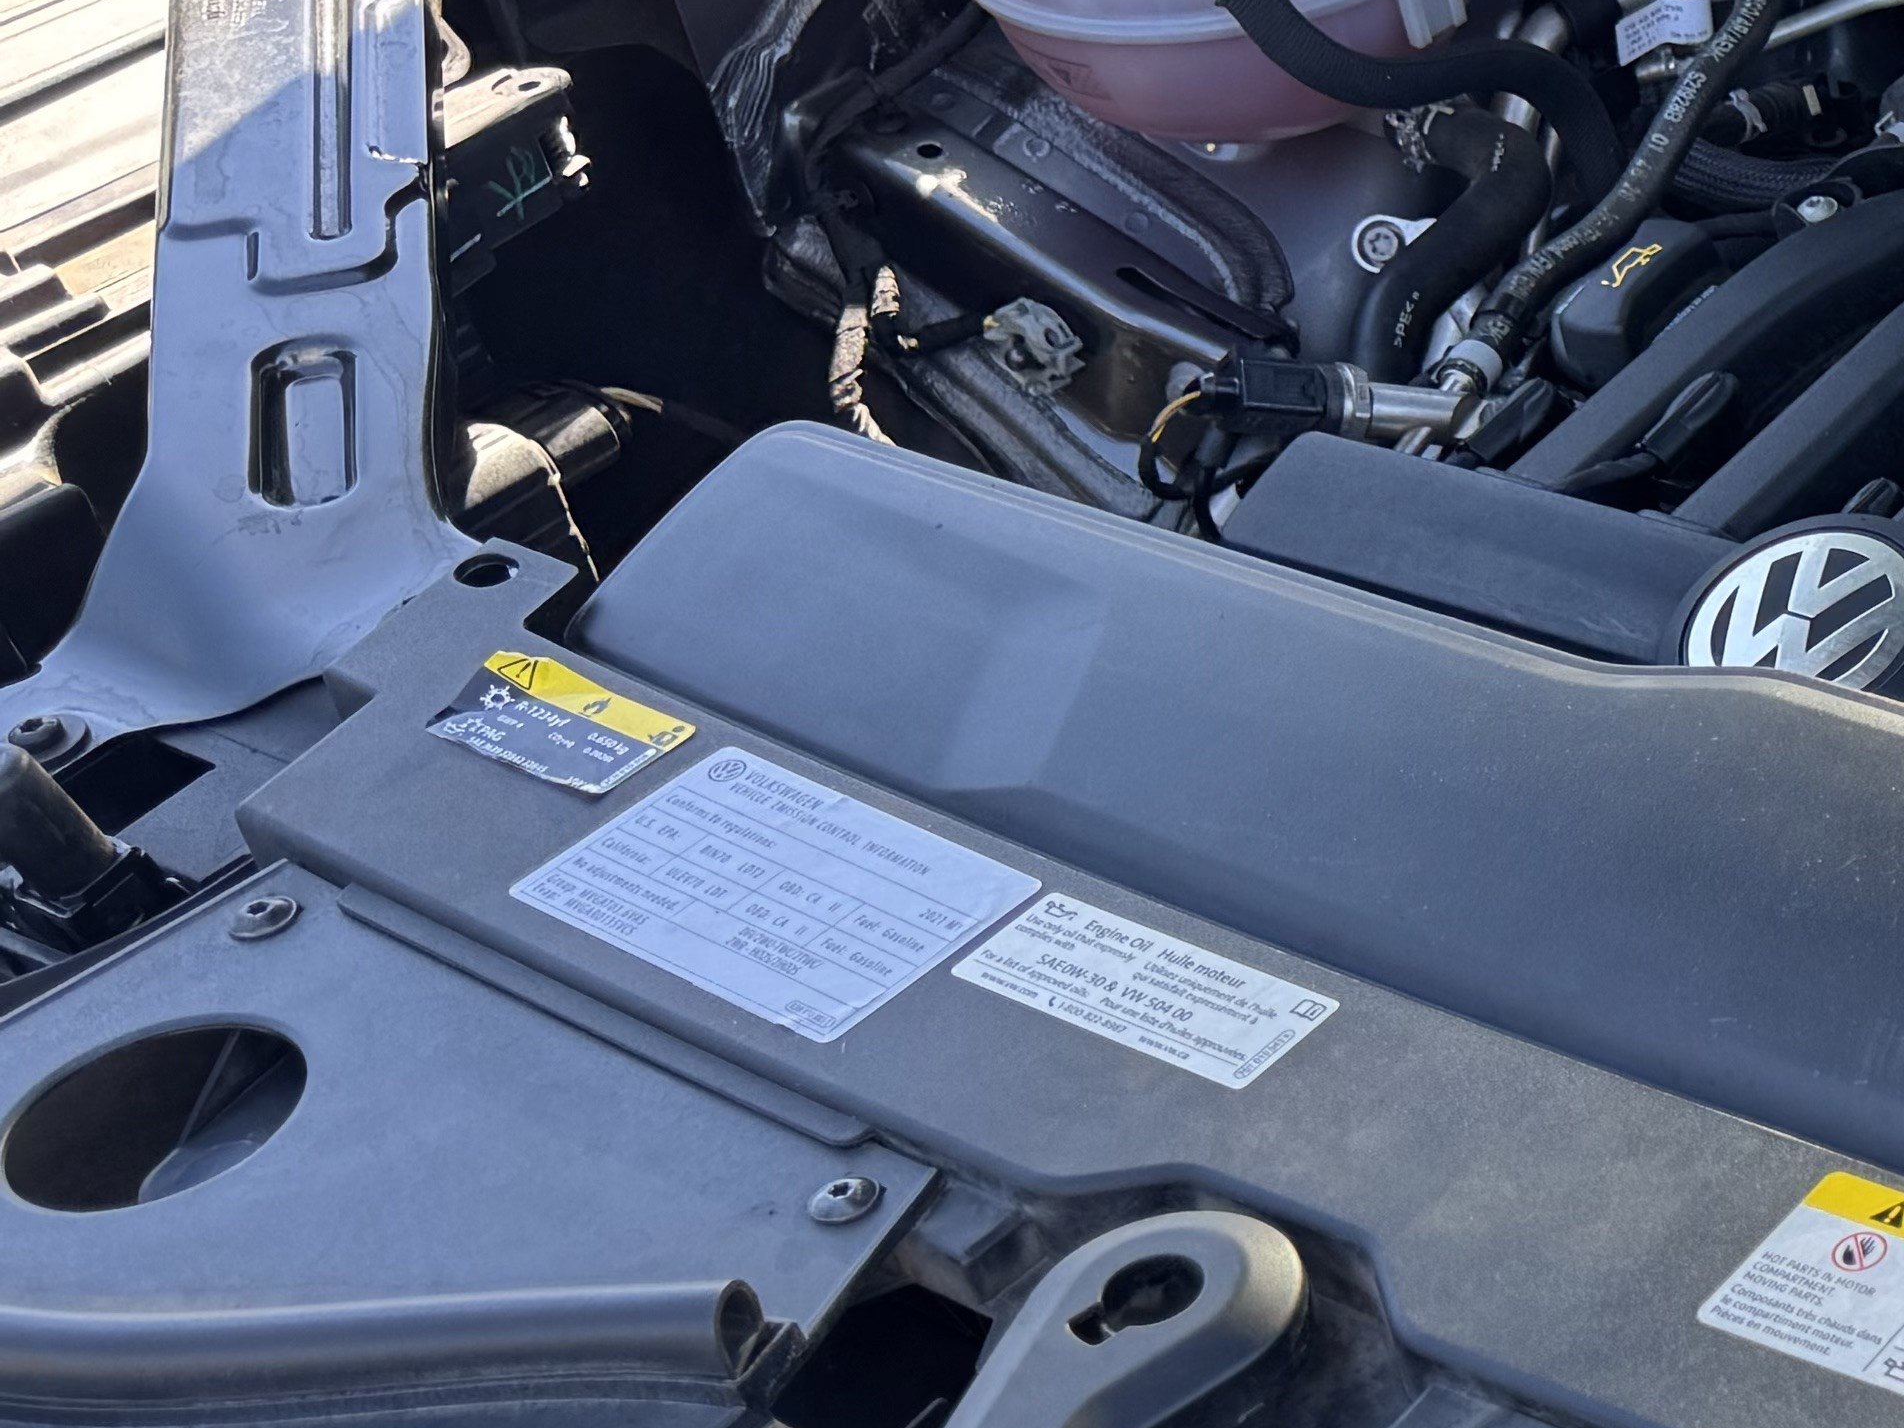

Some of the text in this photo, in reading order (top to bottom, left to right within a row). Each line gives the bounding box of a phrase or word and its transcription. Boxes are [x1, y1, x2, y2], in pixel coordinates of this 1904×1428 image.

[663, 794, 713, 818] Conforms
[741, 771, 825, 810] VOLKSWAGEN
[726, 782, 933, 875] VEHICLE EMISSION CONTROL INFORMATION
[584, 863, 646, 894] adjustments
[916, 908, 948, 925] 2021
[880, 926, 930, 952] Gasoline
[1079, 919, 1155, 951] Engine Oil
[847, 950, 897, 976] Gasoline
[1156, 948, 1249, 989] Huile moteur
[1101, 980, 1121, 992] &
[1117, 986, 1149, 1003] VW
[1142, 996, 1175, 1013] 504
[1169, 1007, 1196, 1022] 00
[1741, 1271, 1789, 1292] MOVING
[1760, 1251, 1787, 1265] HOT
[1784, 1259, 1822, 1277] PARTS
[1832, 1276, 1877, 1297] MOTOR
[1708, 1305, 1748, 1324] Pièces
[1728, 1283, 1886, 1345] Composants très chauds dans
[1730, 1298, 1813, 1333] compartiment
